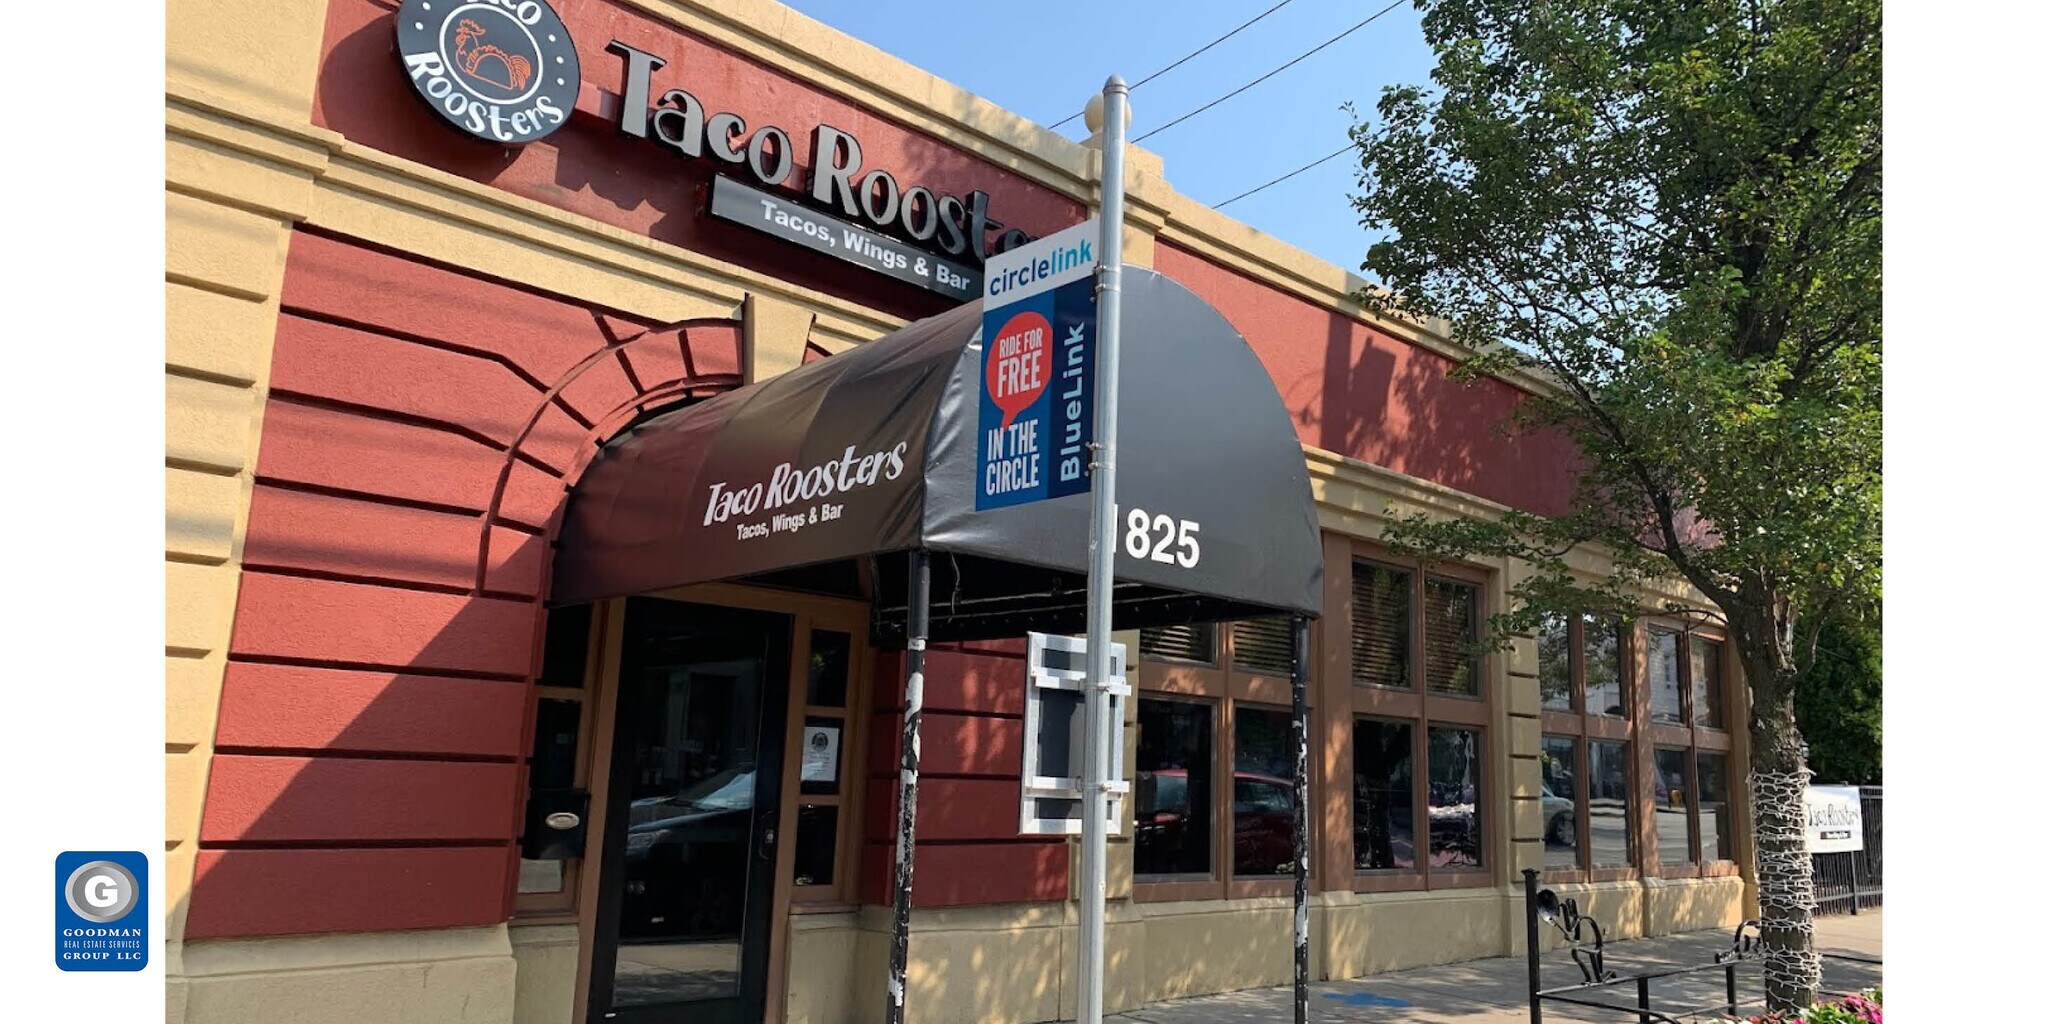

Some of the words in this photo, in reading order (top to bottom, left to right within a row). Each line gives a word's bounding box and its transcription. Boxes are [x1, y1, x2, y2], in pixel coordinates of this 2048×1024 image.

[404, 51, 564, 142] Roosters
[604, 39, 794, 186] Taco
[760, 199, 836, 247] Tacos,
[843, 229, 907, 269] Wings
[913, 256, 930, 277] &
[936, 263, 970, 291] Bar
[989, 238, 1093, 296] circlelink
[999, 336, 1021, 359] RIDE
[1023, 327, 1043, 352] FOR
[997, 350, 1041, 398] FREE
[1060, 321, 1085, 482] BlueLink
[987, 426, 1005, 461] IN
[1008, 418, 1039, 455] THE
[703, 482, 763, 527] Taco
[764, 441, 907, 510] Roosters
[985, 453, 1040, 497] CIRCLE
[736, 522, 770, 541] Tacos,
[772, 512, 805, 533] Wings
[808, 508, 818, 524] &
[821, 502, 844, 522] Bar
